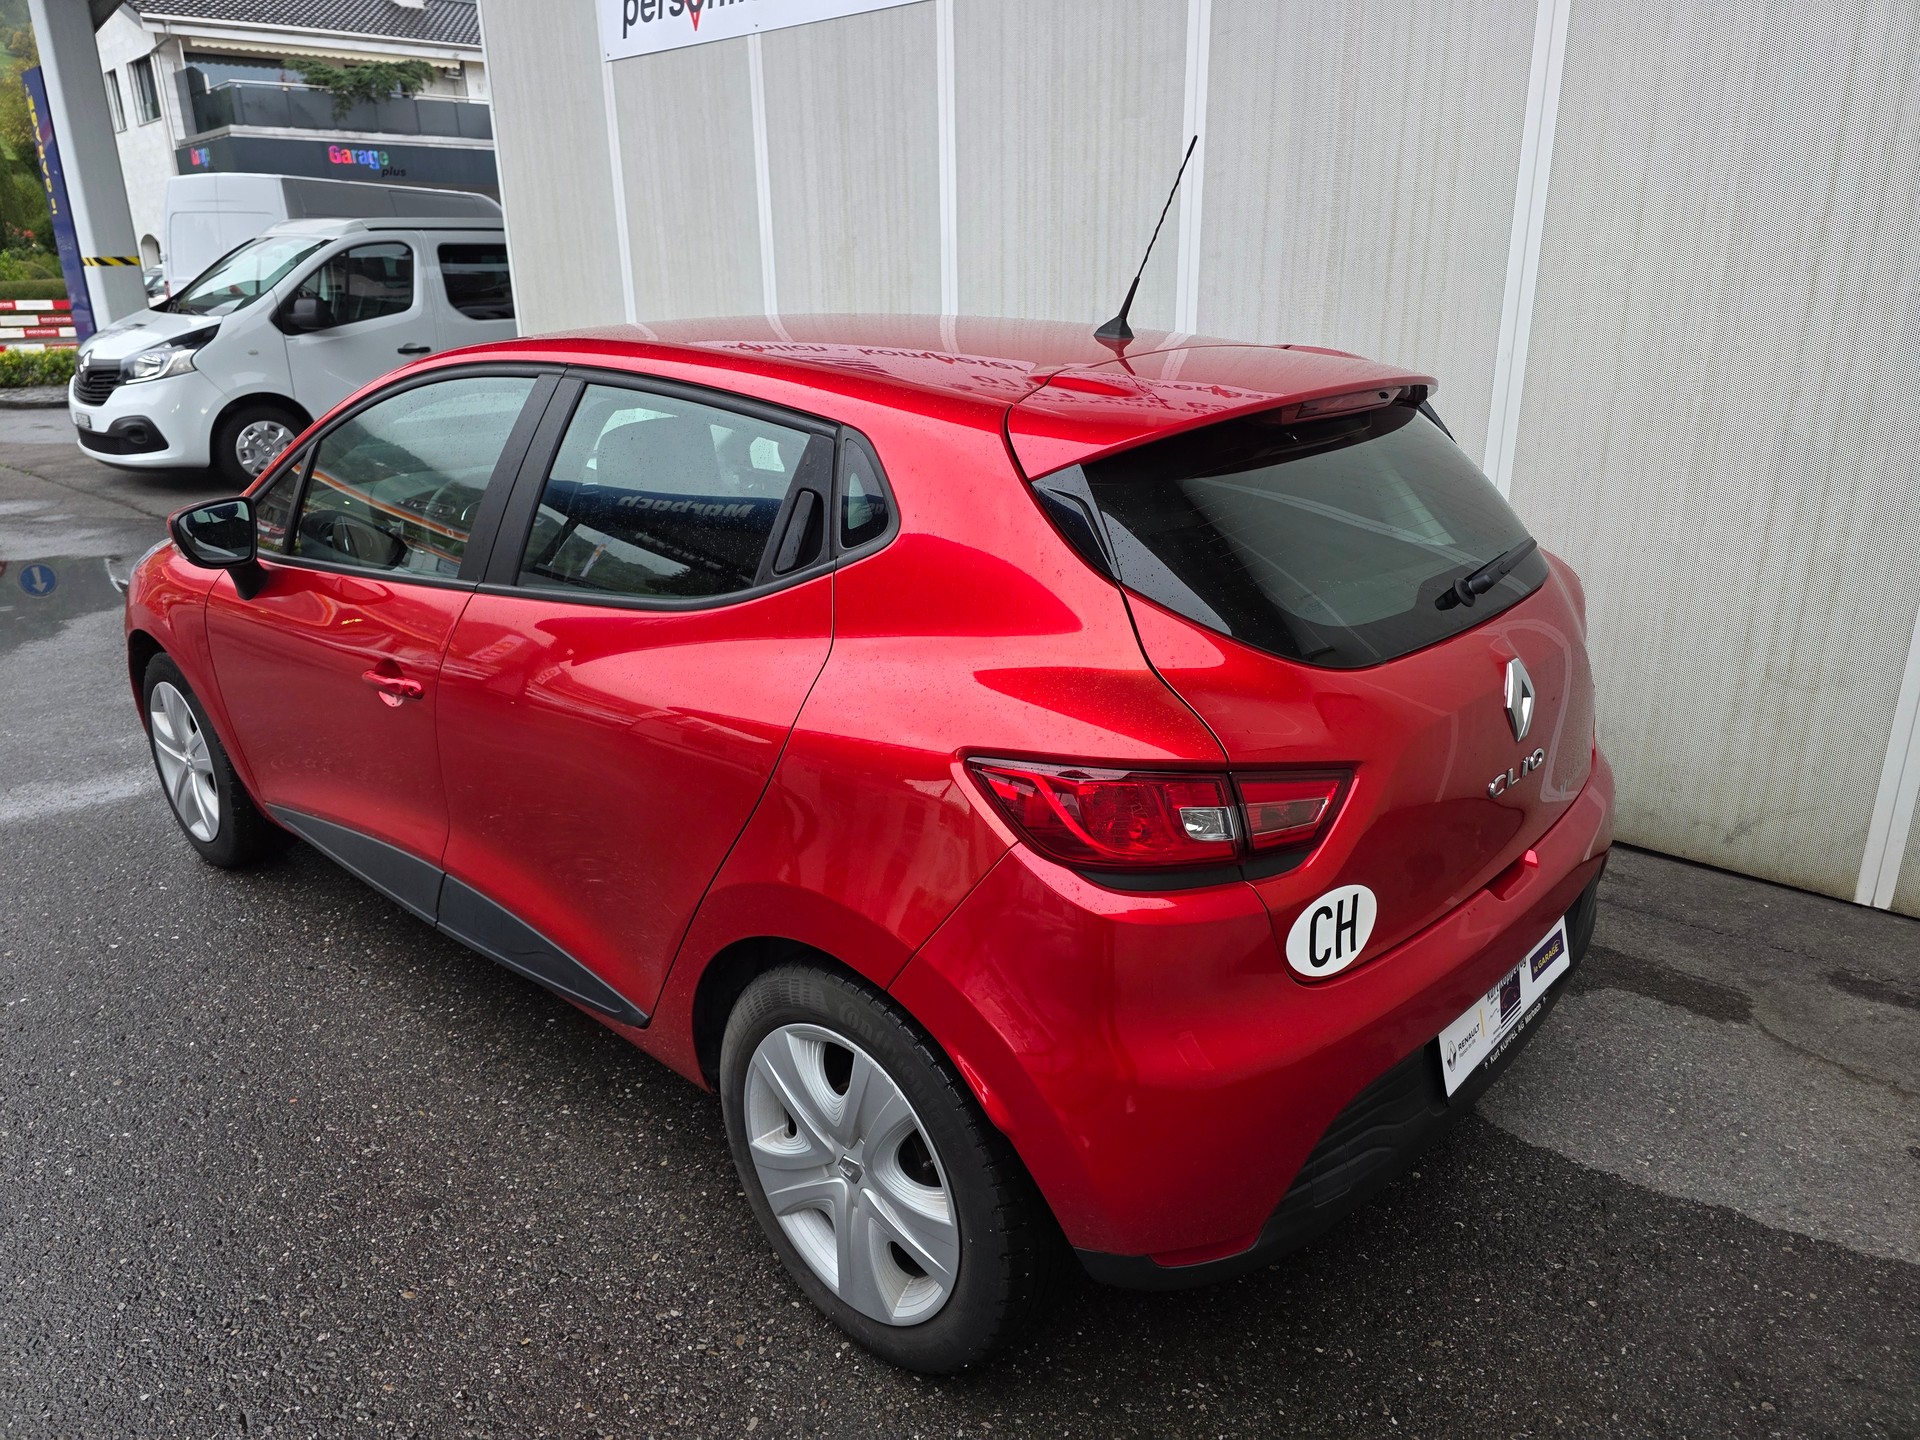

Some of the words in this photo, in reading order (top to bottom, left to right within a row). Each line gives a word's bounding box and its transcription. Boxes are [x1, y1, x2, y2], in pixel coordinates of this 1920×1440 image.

[328, 145, 389, 170] Garage
[381, 166, 407, 178] plus
[1487, 747, 1545, 799] CLIO
[1308, 893, 1359, 968] CH
[1537, 944, 1560, 971] GARAGE
[1457, 1022, 1480, 1051] RENAULT
